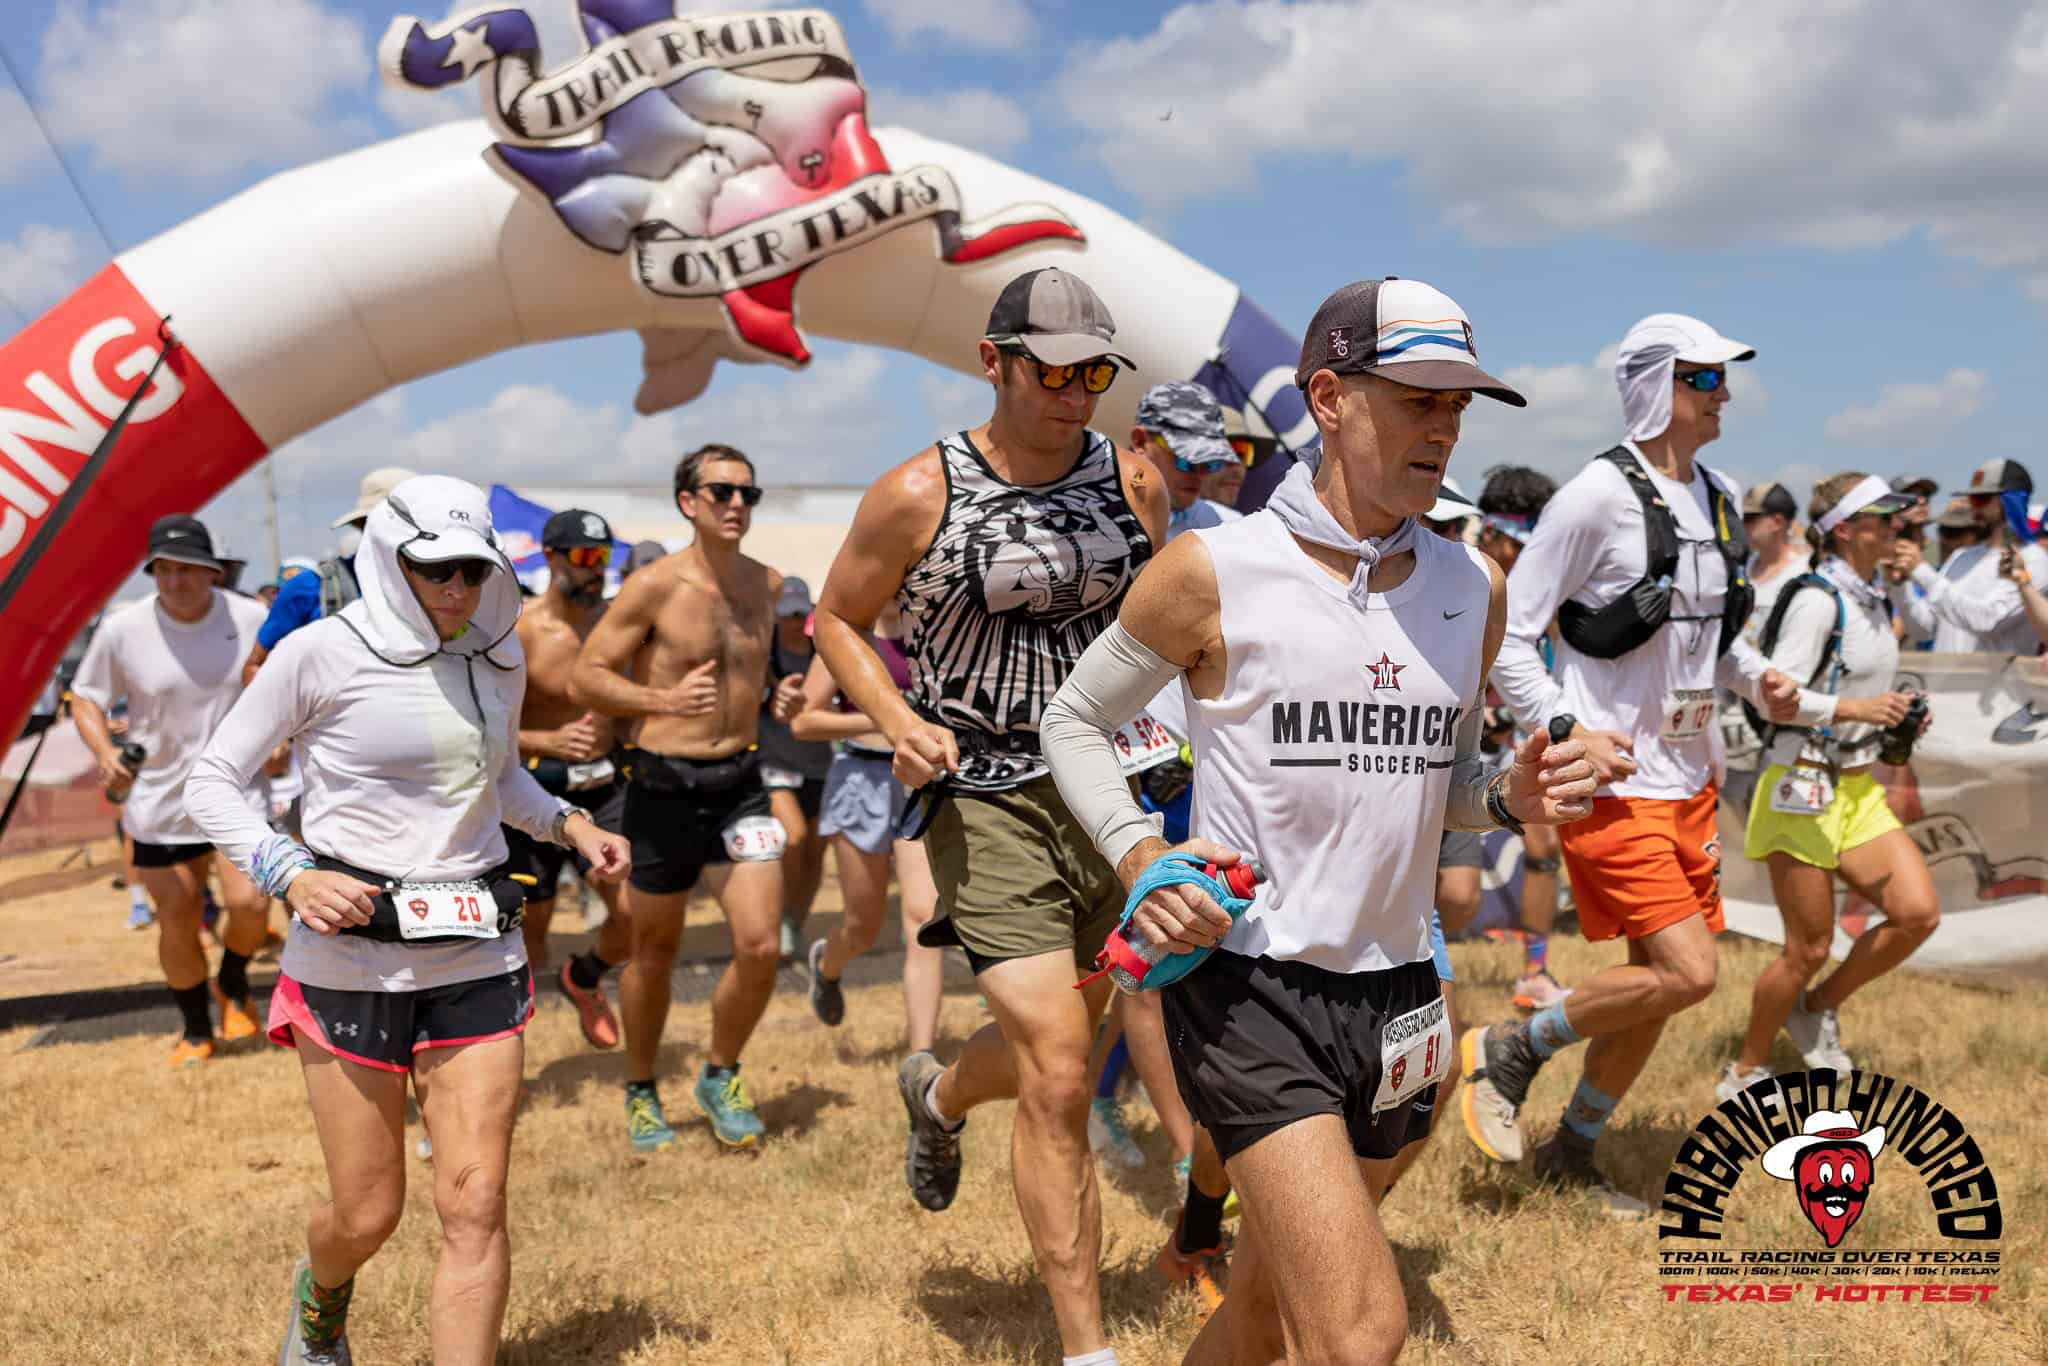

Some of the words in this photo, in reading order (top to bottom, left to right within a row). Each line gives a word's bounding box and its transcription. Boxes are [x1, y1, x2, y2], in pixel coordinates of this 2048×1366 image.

[537, 46, 657, 129] TRAIL
[658, 15, 828, 68] RACING
[671, 229, 793, 287] OVER
[792, 175, 940, 251] TEXAS
[1272, 701, 1463, 746] MAVERICK
[1348, 753, 1426, 775] SOCCER
[453, 896, 482, 922] 20
[1424, 1032, 1441, 1078] 81
